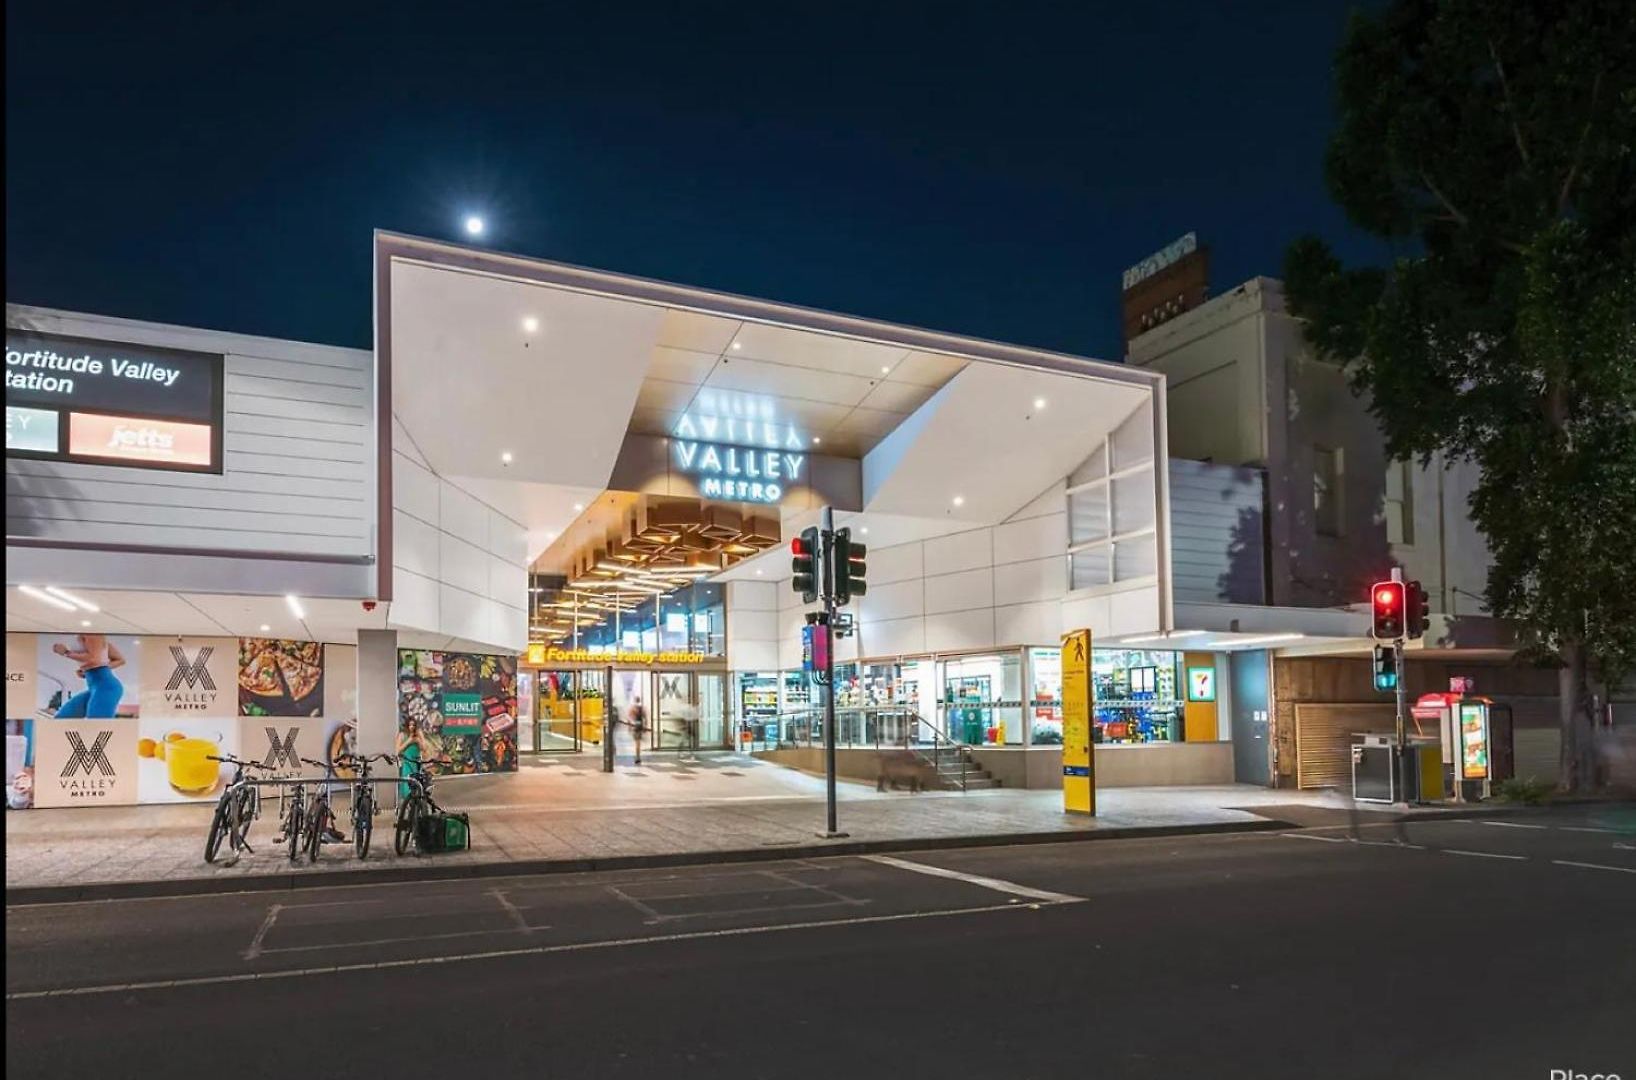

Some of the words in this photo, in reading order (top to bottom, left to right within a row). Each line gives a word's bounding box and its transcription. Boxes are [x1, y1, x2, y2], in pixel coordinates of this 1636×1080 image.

[6, 347, 103, 374] ortitude
[111, 358, 181, 386] Valley
[107, 426, 175, 449] jetts
[676, 440, 804, 480] VALLEY
[704, 478, 781, 501] METRO
[165, 692, 217, 703] VALLEY
[445, 702, 480, 712] SUNLIT
[60, 779, 116, 790] VALLEY
[70, 790, 105, 798] METRO
